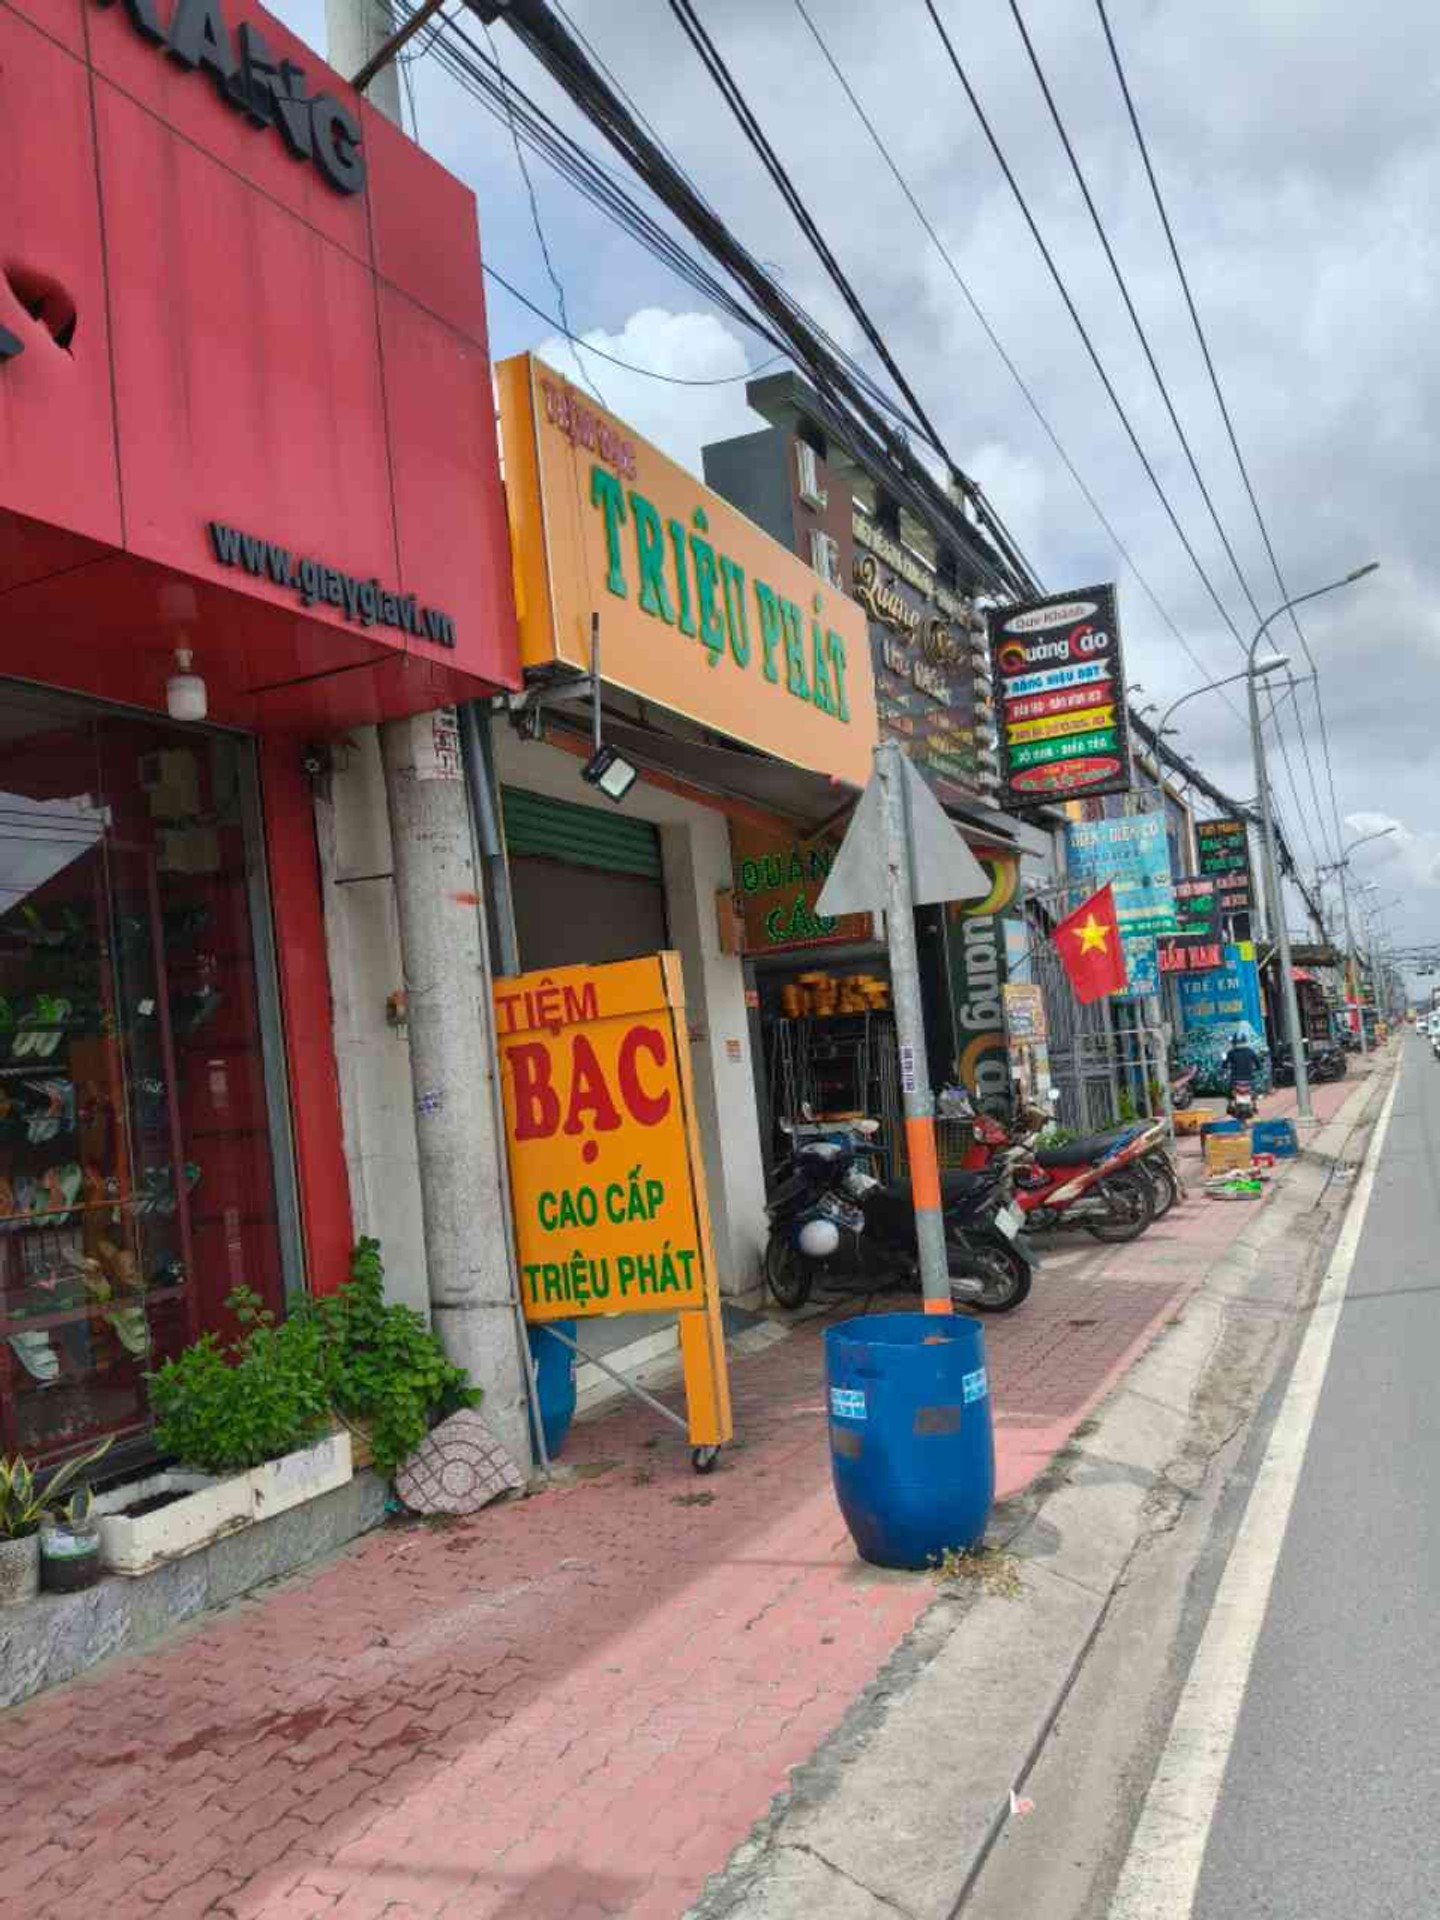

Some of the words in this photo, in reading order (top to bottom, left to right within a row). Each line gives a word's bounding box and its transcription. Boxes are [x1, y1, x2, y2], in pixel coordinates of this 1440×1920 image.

[590, 463, 750, 670] TRIỆU
[753, 577, 851, 725] PHÁT
[496, 977, 600, 1037] TIỆM
[506, 1023, 671, 1165] BẠC
[537, 1185, 599, 1232] CAO
[605, 1163, 664, 1225] CẤP
[524, 1250, 610, 1307] TRIỆU
[616, 1240, 696, 1297] PHÁT
